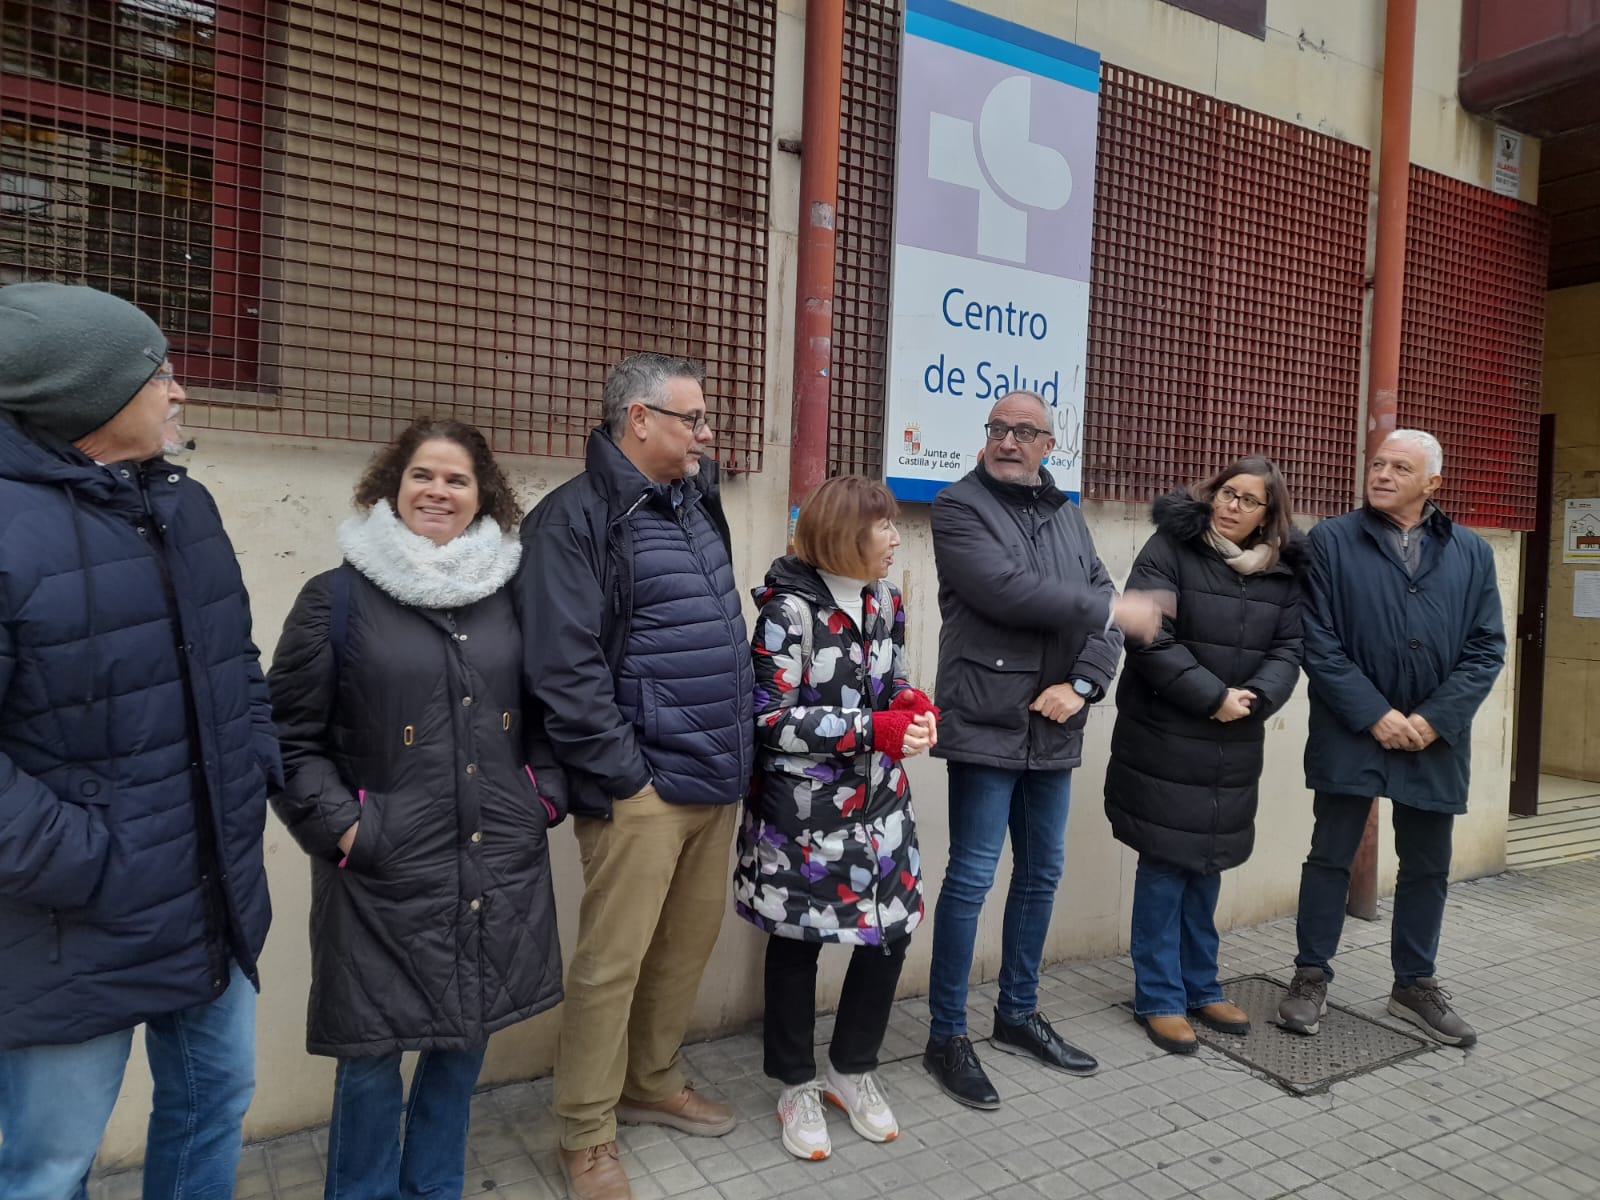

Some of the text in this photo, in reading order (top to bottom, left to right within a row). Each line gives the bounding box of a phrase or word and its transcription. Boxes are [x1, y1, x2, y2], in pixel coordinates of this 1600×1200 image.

[942, 287, 1048, 340] Centro
[924, 353, 1059, 407] de Salud
[898, 456, 961, 470] Castilla y León
[923, 448, 961, 460] Junta de
